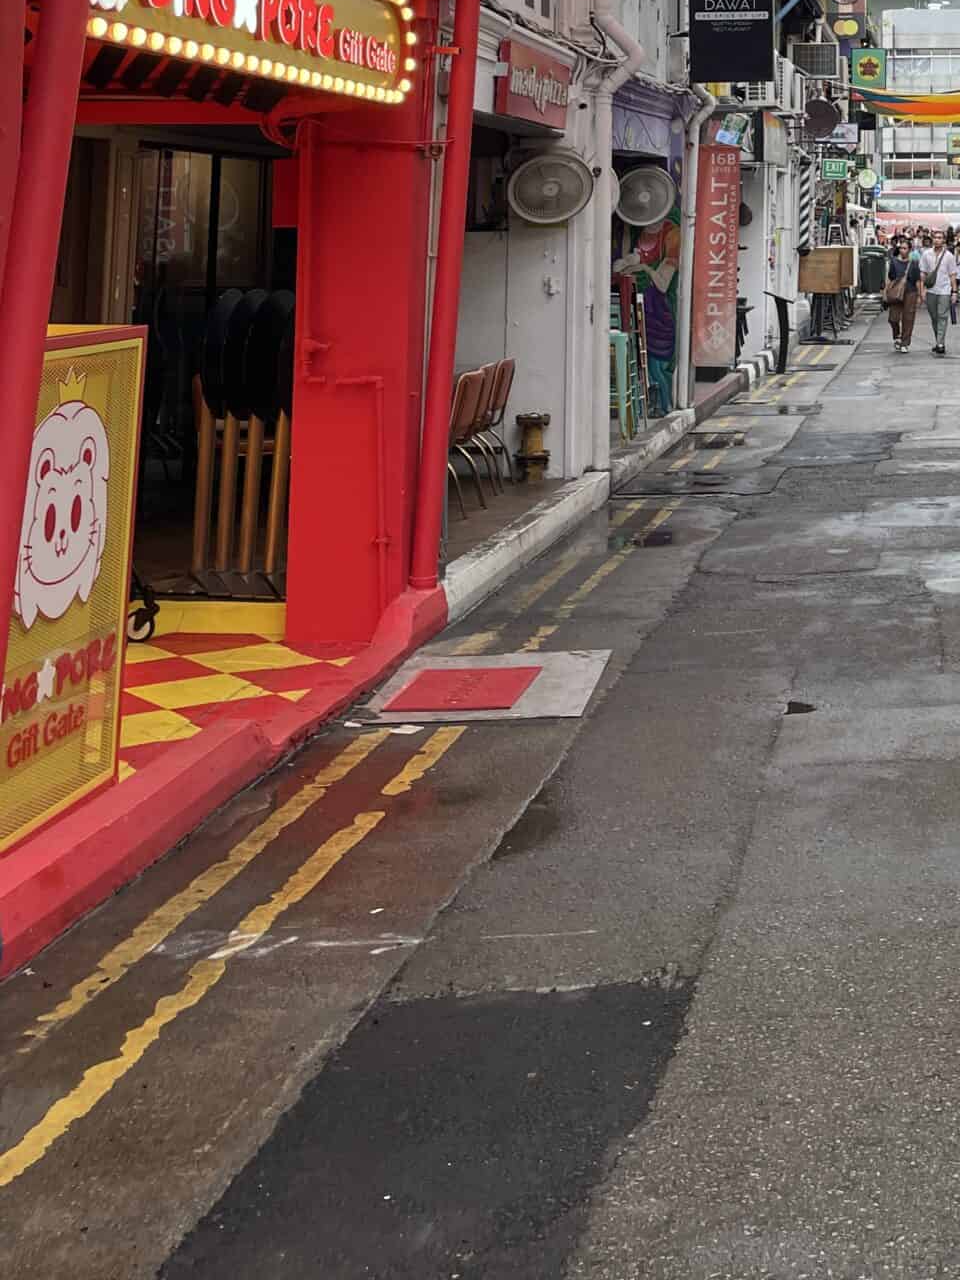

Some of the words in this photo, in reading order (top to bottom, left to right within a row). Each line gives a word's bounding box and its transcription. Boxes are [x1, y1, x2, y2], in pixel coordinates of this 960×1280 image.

[339, 27, 364, 64] Gift
[366, 35, 397, 73] Gate
[711, 153, 737, 165] 16B
[826, 162, 844, 172] EXIT
[705, 176, 729, 316] PINKSALT
[7, 722, 40, 769] Gift
[43, 703, 85, 747] Gate
